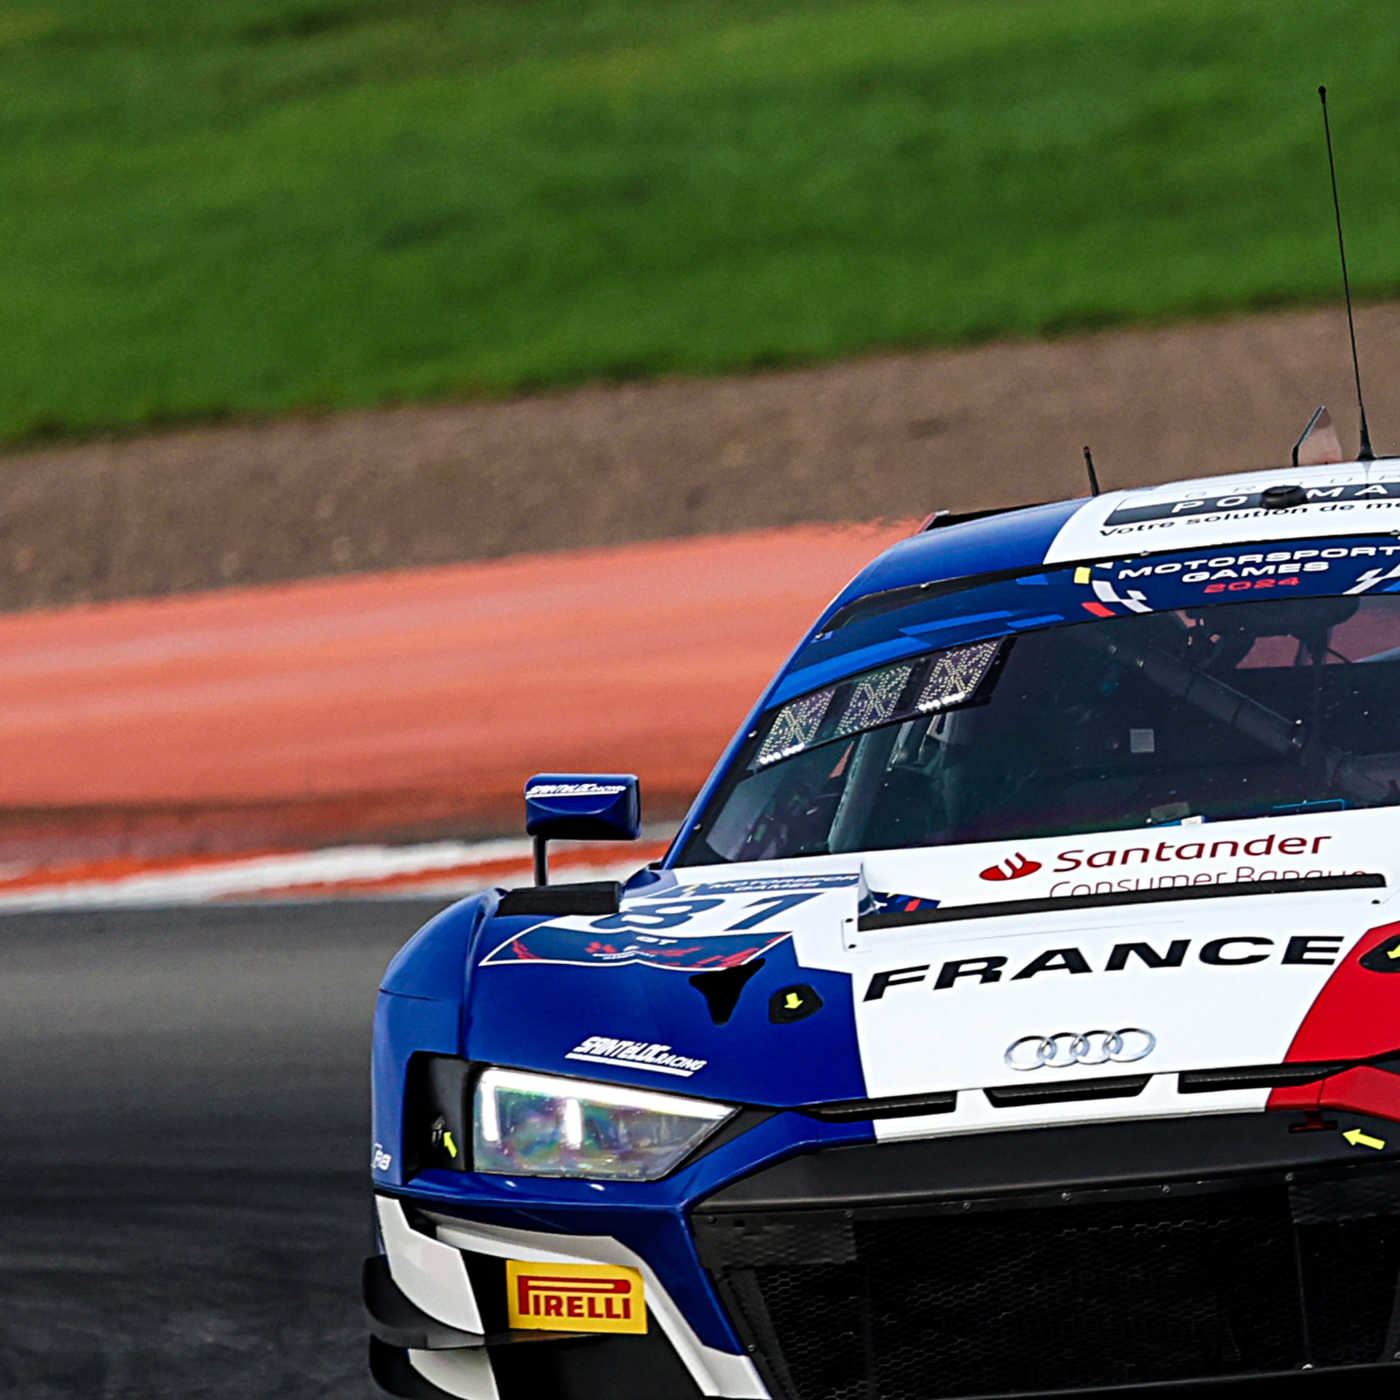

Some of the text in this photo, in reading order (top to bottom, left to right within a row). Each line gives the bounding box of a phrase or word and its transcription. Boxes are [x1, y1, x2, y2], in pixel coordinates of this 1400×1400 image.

[1100, 521, 1175, 537] Votre
[1186, 506, 1308, 525] solution
[1319, 504, 1355, 512] de
[1182, 561, 1329, 583] GAMES
[1203, 576, 1300, 594] 2024
[1053, 834, 1332, 873] Santander
[862, 936, 1345, 1003] FRANCE
[518, 1274, 631, 1319] PIRELLI
